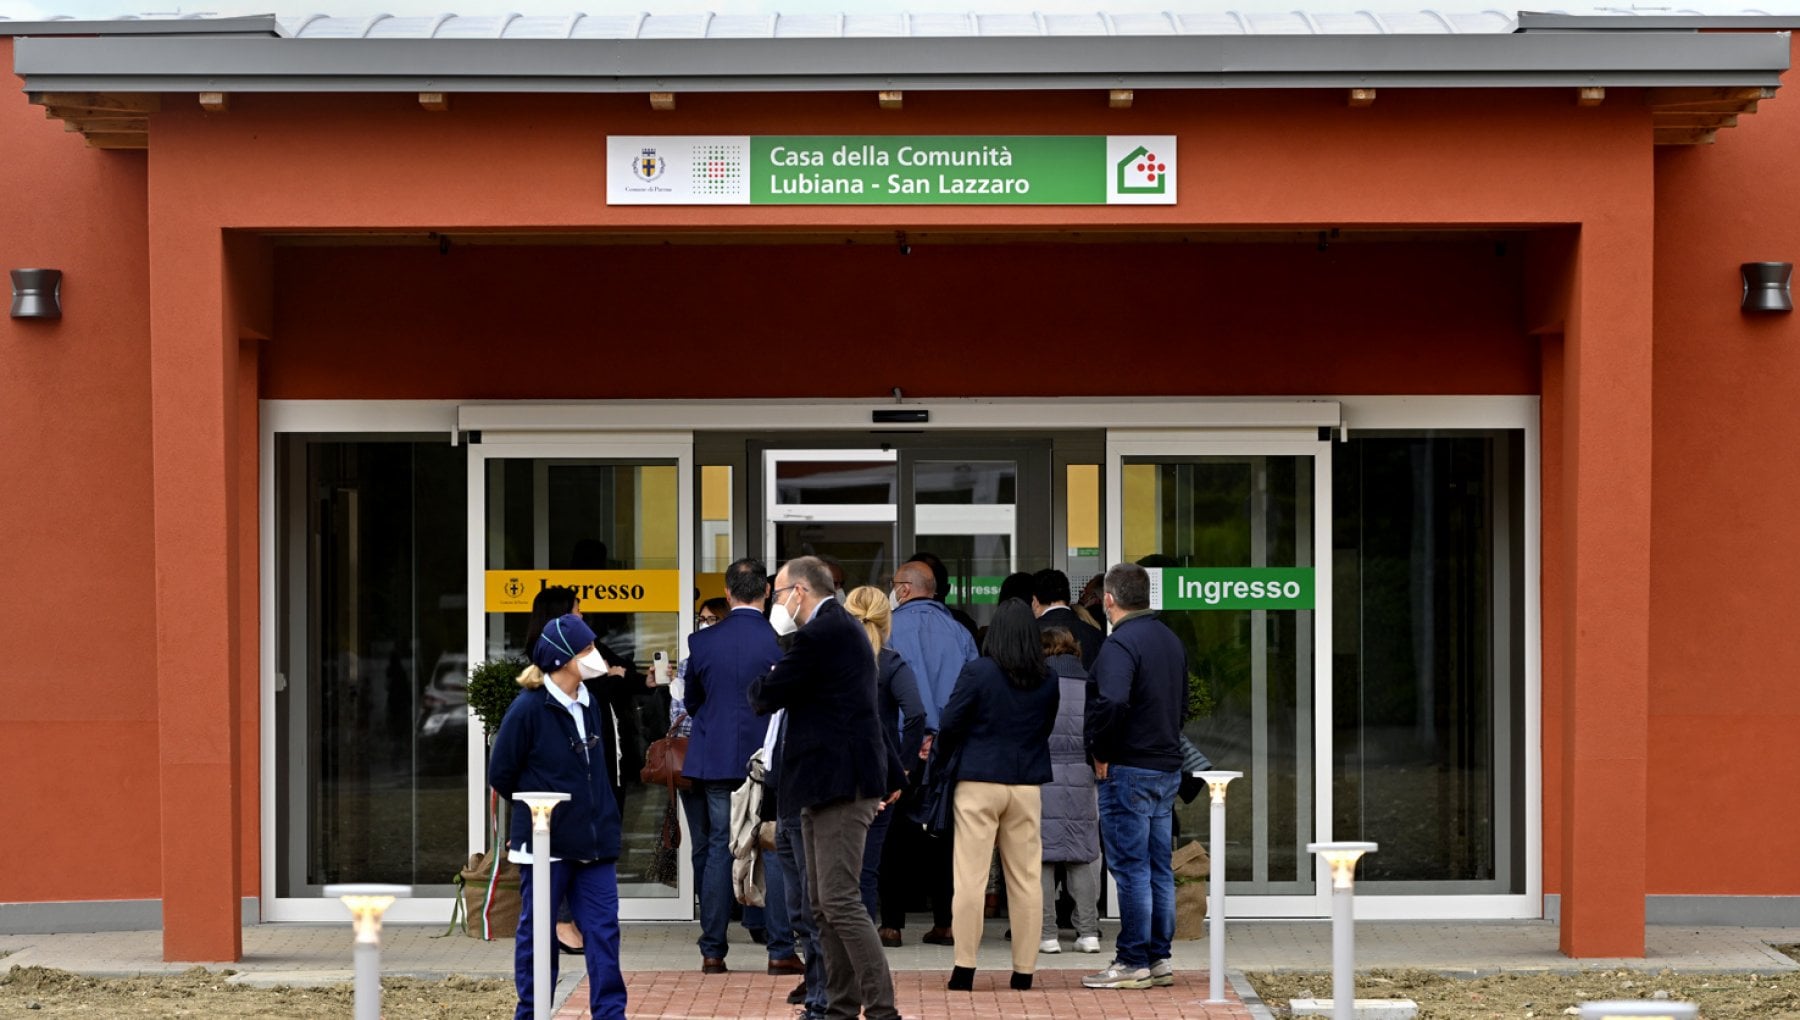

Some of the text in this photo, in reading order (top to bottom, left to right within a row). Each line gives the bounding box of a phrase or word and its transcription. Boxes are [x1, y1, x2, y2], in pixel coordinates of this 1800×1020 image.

[770, 145, 1012, 166] Casa della Comunità
[771, 173, 864, 194] Lubiana
[888, 174, 930, 194] San
[939, 174, 1030, 194] Lazzaro
[539, 578, 645, 603] Igresso
[1178, 575, 1300, 605] Ingresso
